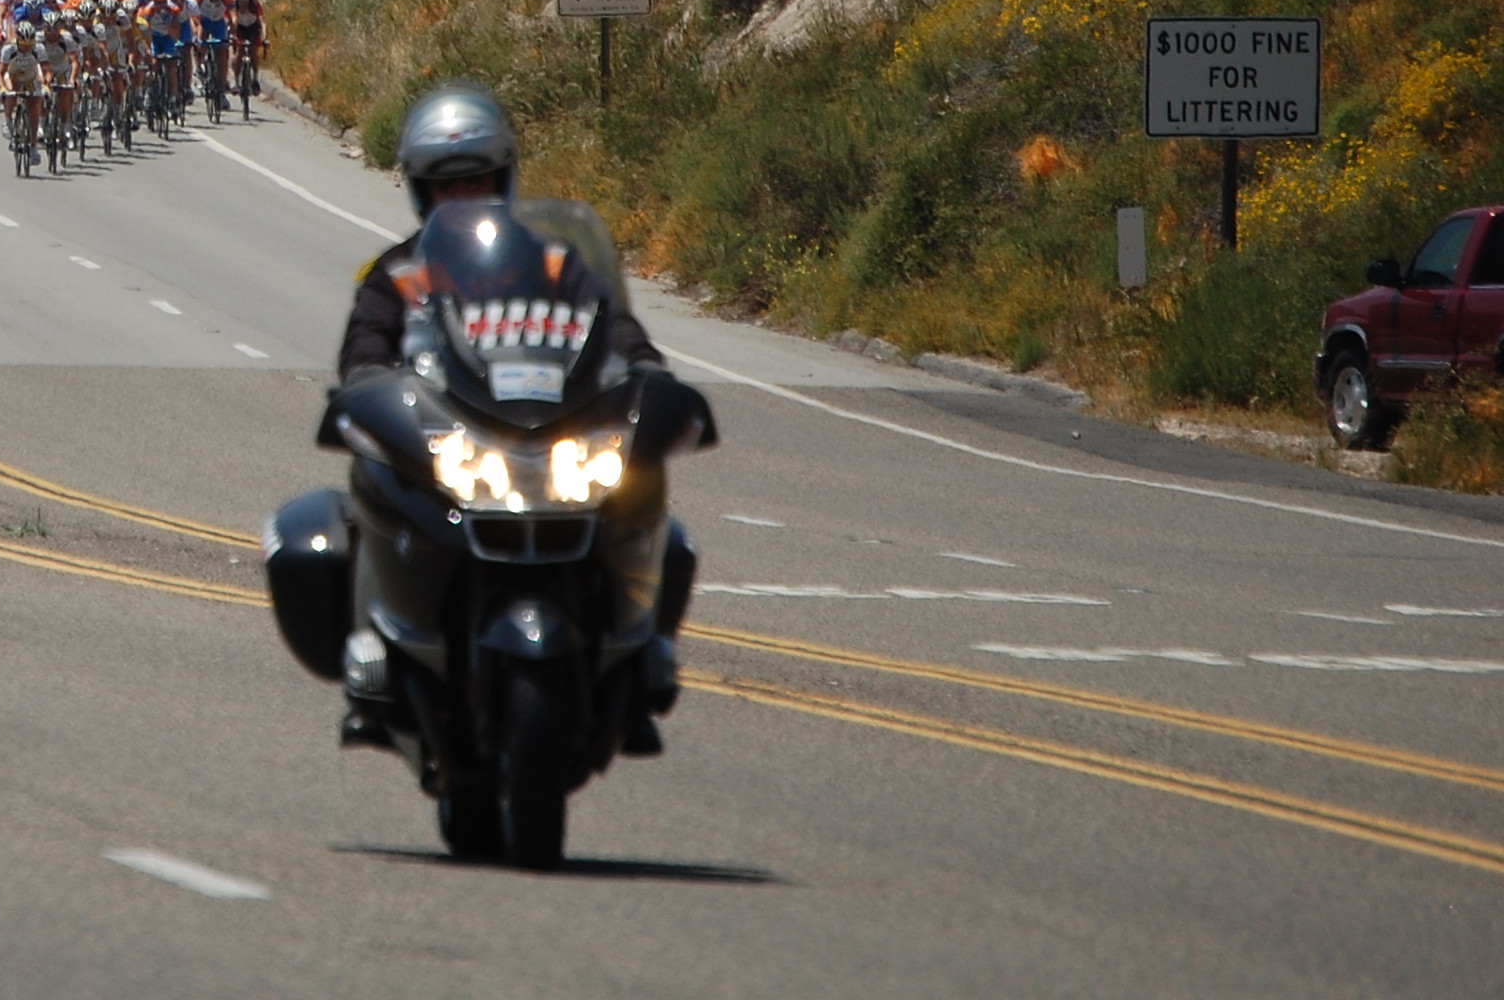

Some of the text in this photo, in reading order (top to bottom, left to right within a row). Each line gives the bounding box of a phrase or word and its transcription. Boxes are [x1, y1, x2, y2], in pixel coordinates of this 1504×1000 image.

[1156, 30, 1311, 56] $1000 FINE
[1209, 66, 1259, 89] FOR
[1166, 100, 1299, 123] LITTERING
